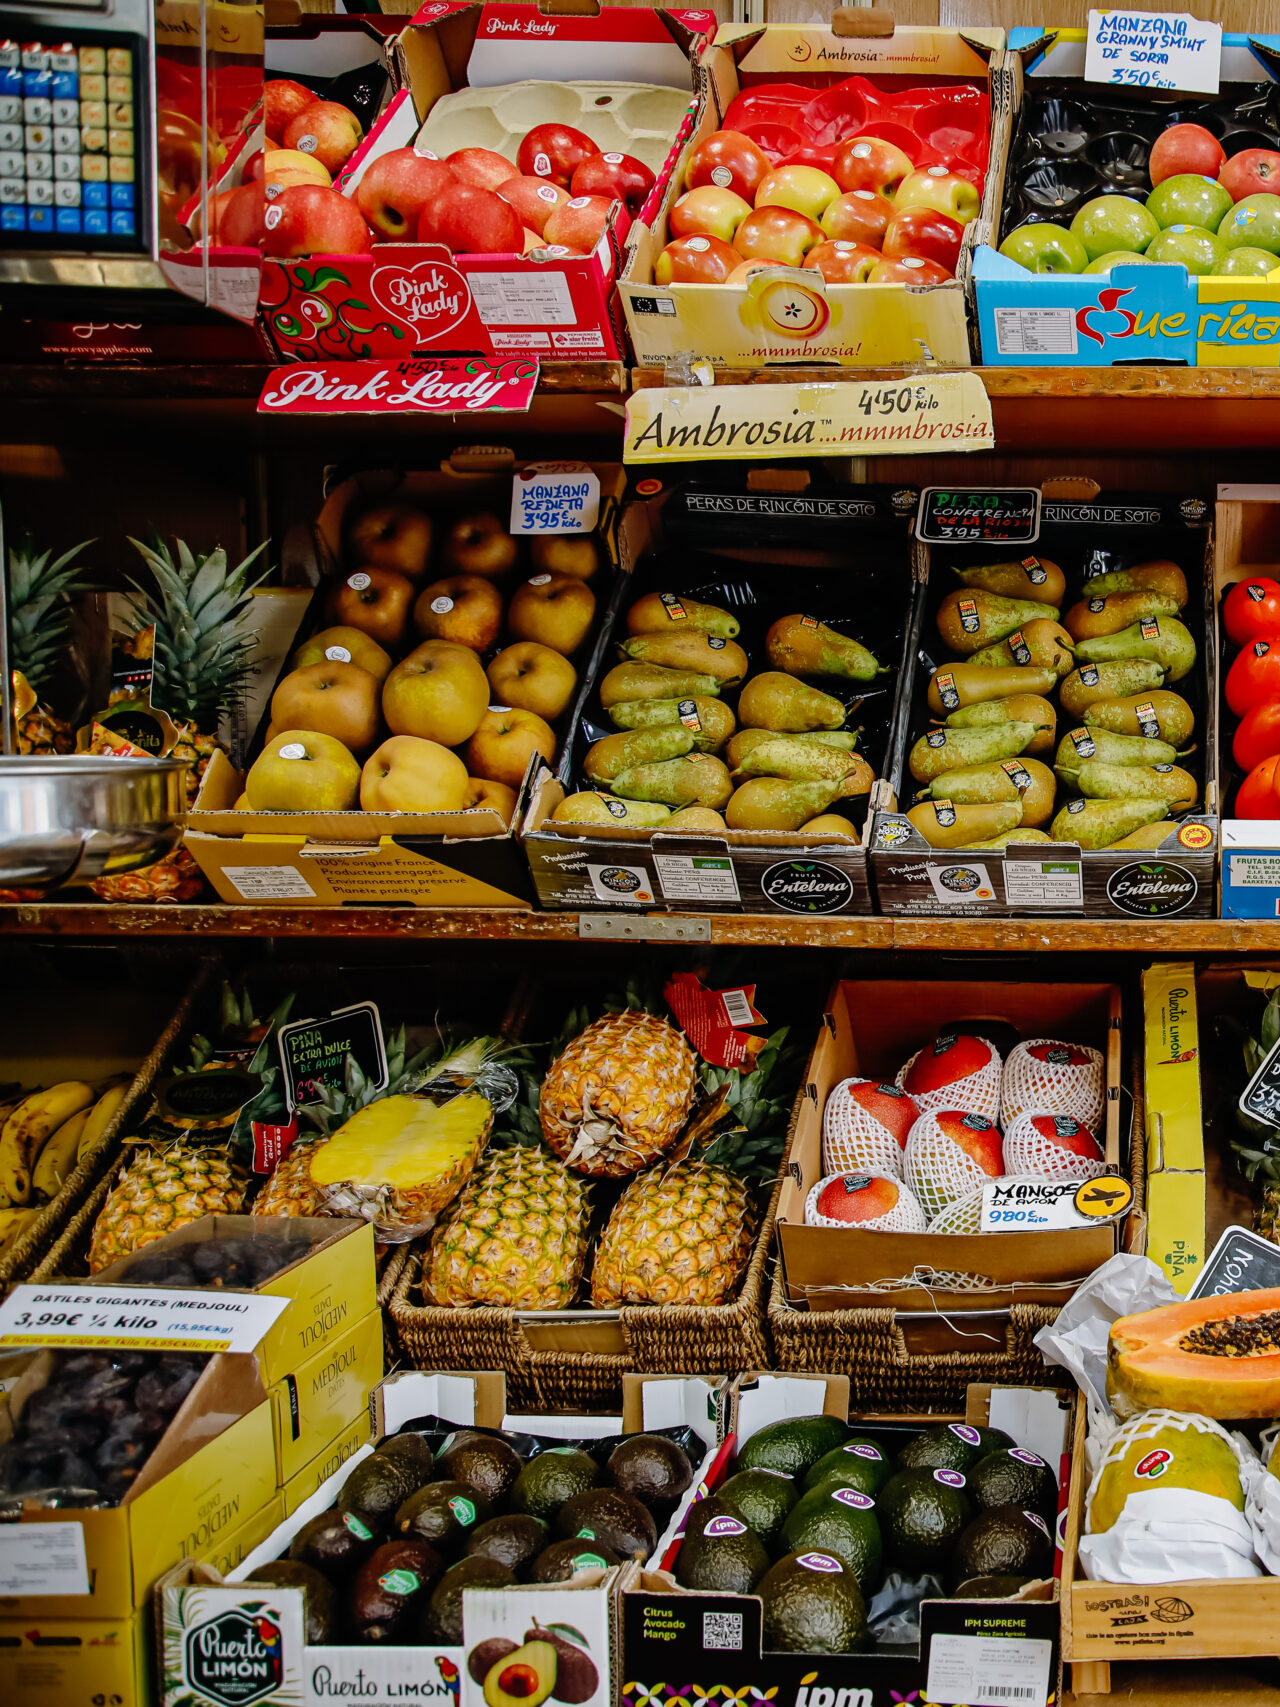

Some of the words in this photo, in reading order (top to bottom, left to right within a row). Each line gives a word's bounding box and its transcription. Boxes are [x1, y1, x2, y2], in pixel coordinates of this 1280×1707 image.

[487, 18, 521, 34] Pink
[522, 20, 557, 36] Lady
[1100, 16, 1188, 36] MANZANA
[1096, 31, 1158, 51] GRANNY
[816, 48, 878, 63] Ambrosia
[1102, 48, 1119, 60] DE
[390, 268, 449, 305] Pink
[263, 369, 390, 407] Pink
[858, 387, 913, 416] 4'50
[522, 483, 590, 499] MANZANA
[686, 496, 733, 512] PERAS
[737, 498, 756, 512] DE
[759, 497, 815, 514] RINCÓN
[818, 501, 837, 515] DE
[839, 502, 876, 516] SOTO
[1044, 505, 1100, 521] RINCÓN
[1104, 508, 1122, 521] DE
[1124, 510, 1161, 523] SOTO
[521, 512, 560, 529] 3'95
[936, 517, 958, 527] DE
[960, 517, 980, 526] LA
[939, 527, 980, 539] 3'95
[315, 858, 350, 867] 100%
[352, 859, 392, 868] origine
[395, 858, 436, 867] France
[321, 868, 393, 877] Producteurs
[394, 868, 445, 878] engagés
[327, 877, 415, 885] Environnement
[332, 885, 374, 895] Planète
[376, 885, 432, 896] protégée
[763, 878, 848, 896] Entelena
[1112, 880, 1192, 898] Entelena
[324, 1039, 352, 1054] DULCE
[300, 1061, 312, 1073] DE
[991, 1182, 1080, 1199] MANGOS
[989, 1199, 1010, 1207] DE
[33, 1294, 91, 1304] DÁTILES
[96, 1297, 169, 1308] GIGANTES
[170, 1299, 249, 1313] (MEDJOUL)
[14, 1312, 83, 1328] 3,99€
[114, 1313, 158, 1329] kilo
[312, 1345, 357, 1395] MEDJOUL
[843, 1491, 866, 1504] ipm
[714, 1520, 738, 1533] ipm
[808, 1555, 832, 1568] ipm
[643, 1607, 673, 1618] Citrus
[643, 1618, 686, 1630] Avocado
[964, 1618, 982, 1628] IPM
[983, 1618, 1027, 1629] SUPREME
[201, 1623, 267, 1659] Puerto
[643, 1629, 677, 1641] Mango
[202, 1658, 268, 1678] LIMÓN
[312, 1664, 378, 1697] Puerto
[387, 1679, 450, 1697] LIMÓN
